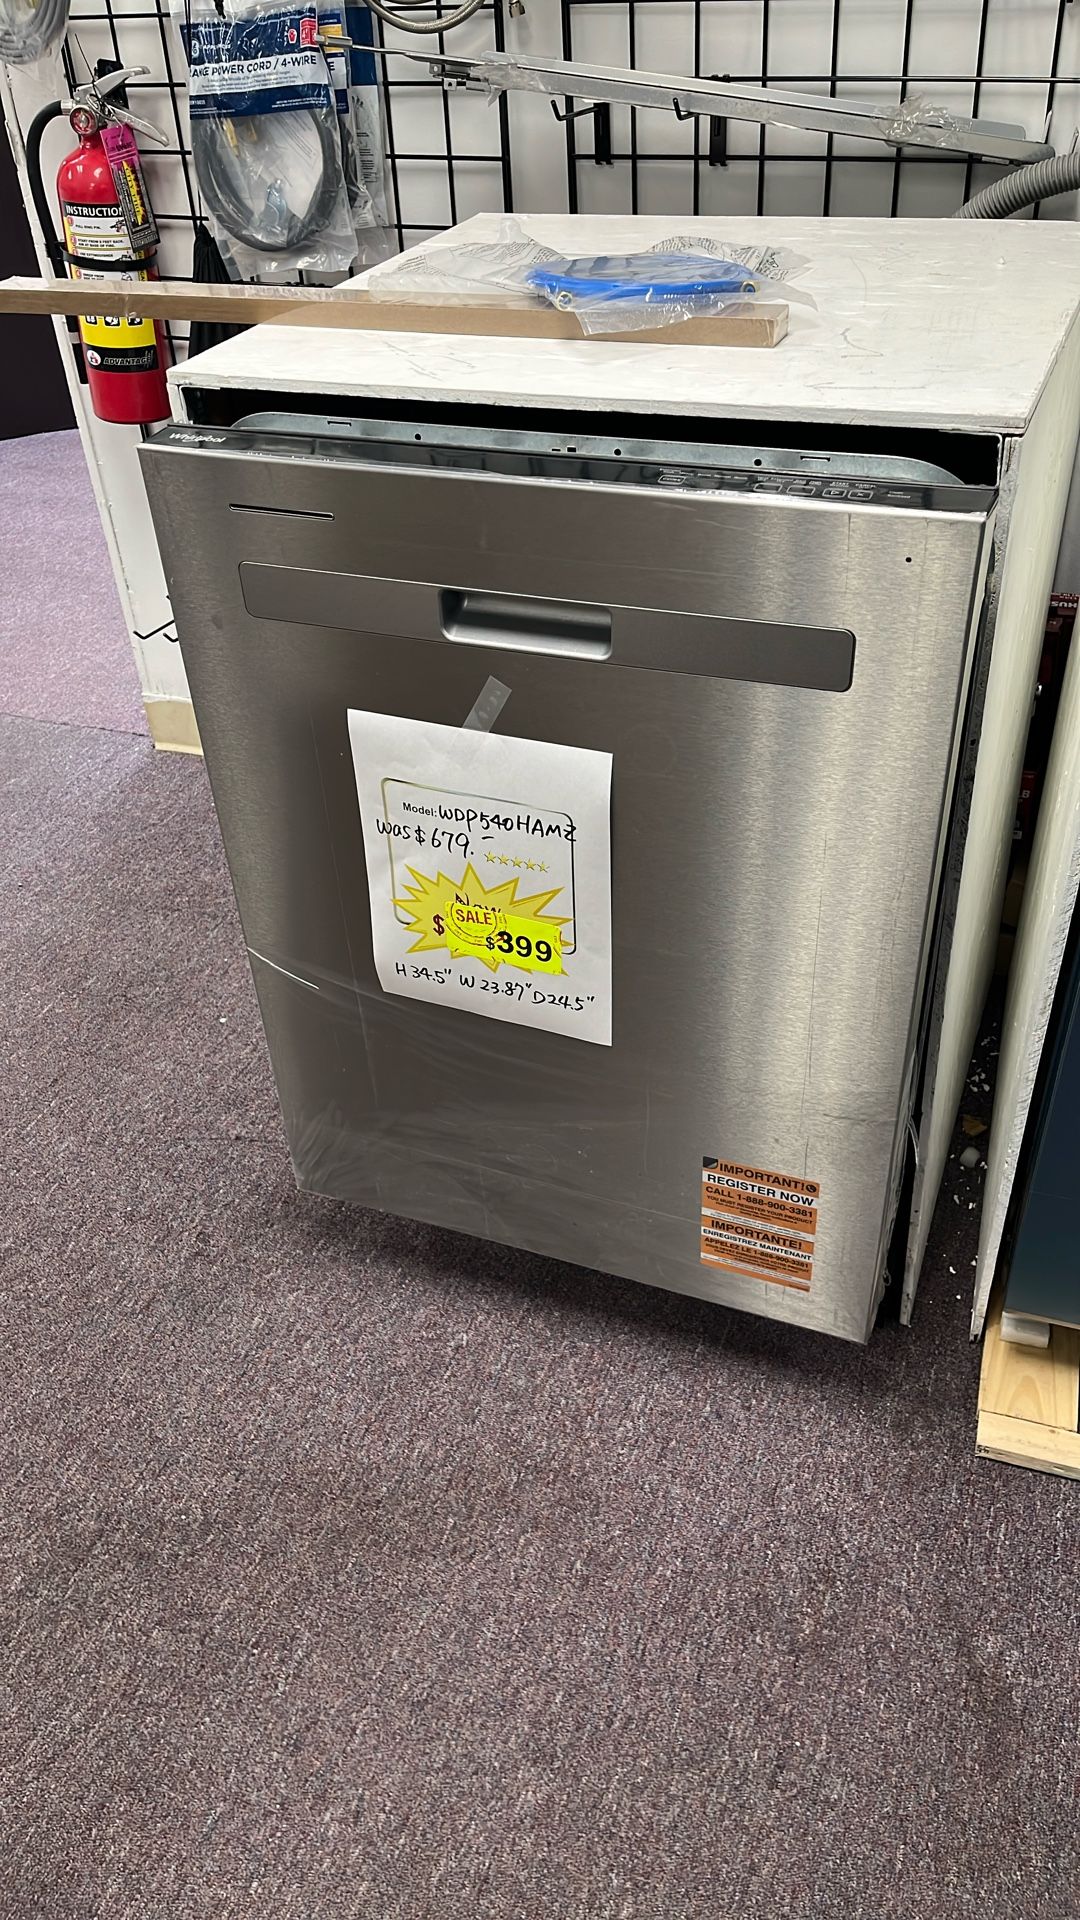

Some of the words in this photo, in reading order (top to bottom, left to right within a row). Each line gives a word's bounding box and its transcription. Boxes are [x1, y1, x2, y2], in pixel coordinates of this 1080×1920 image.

[212, 63, 244, 76] POWER
[247, 60, 272, 72] CORD
[281, 55, 316, 68] 4-WIRE
[402, 801, 438, 818] Model:
[455, 908, 493, 928] SALE
[485, 930, 552, 963] $399
[707, 1174, 776, 1198] REGISTER
[780, 1191, 814, 1206] NOW
[720, 1162, 805, 1191] IMPORTANT!
[706, 1186, 734, 1199] CALL
[738, 1194, 813, 1218] 1-888-900-3381
[703, 1228, 758, 1247] ENREGISTREZ
[759, 1243, 812, 1261] MAINTENANT
[704, 1237, 740, 1252] APPELEZ
[741, 1245, 752, 1254] LE
[711, 1220, 802, 1250] IMPORTANTE!
